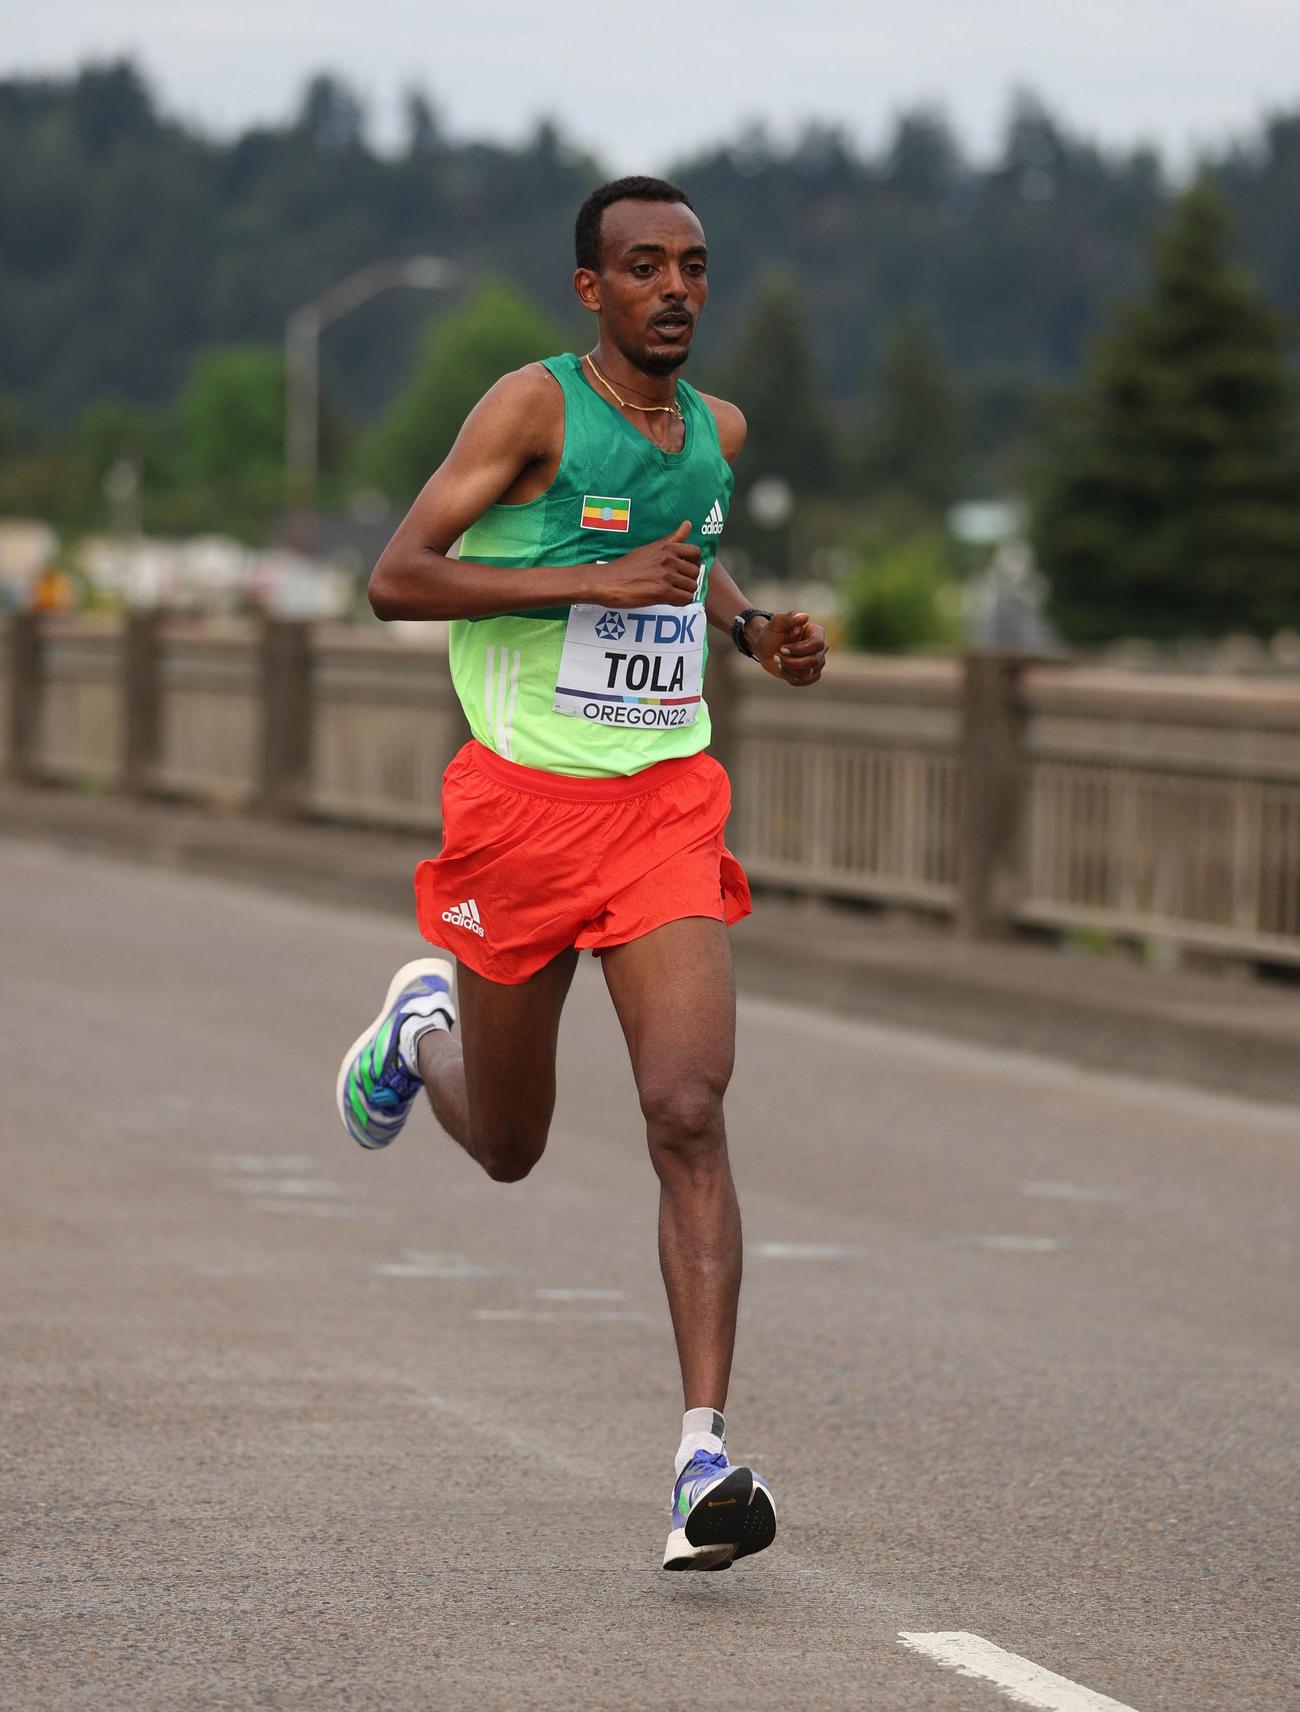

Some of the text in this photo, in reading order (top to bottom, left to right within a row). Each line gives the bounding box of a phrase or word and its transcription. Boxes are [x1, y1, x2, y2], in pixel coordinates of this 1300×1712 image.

[627, 613, 697, 644] TDK
[605, 652, 684, 692] TOLA
[583, 703, 687, 726] OREGON22
[441, 911, 485, 938] adidas
